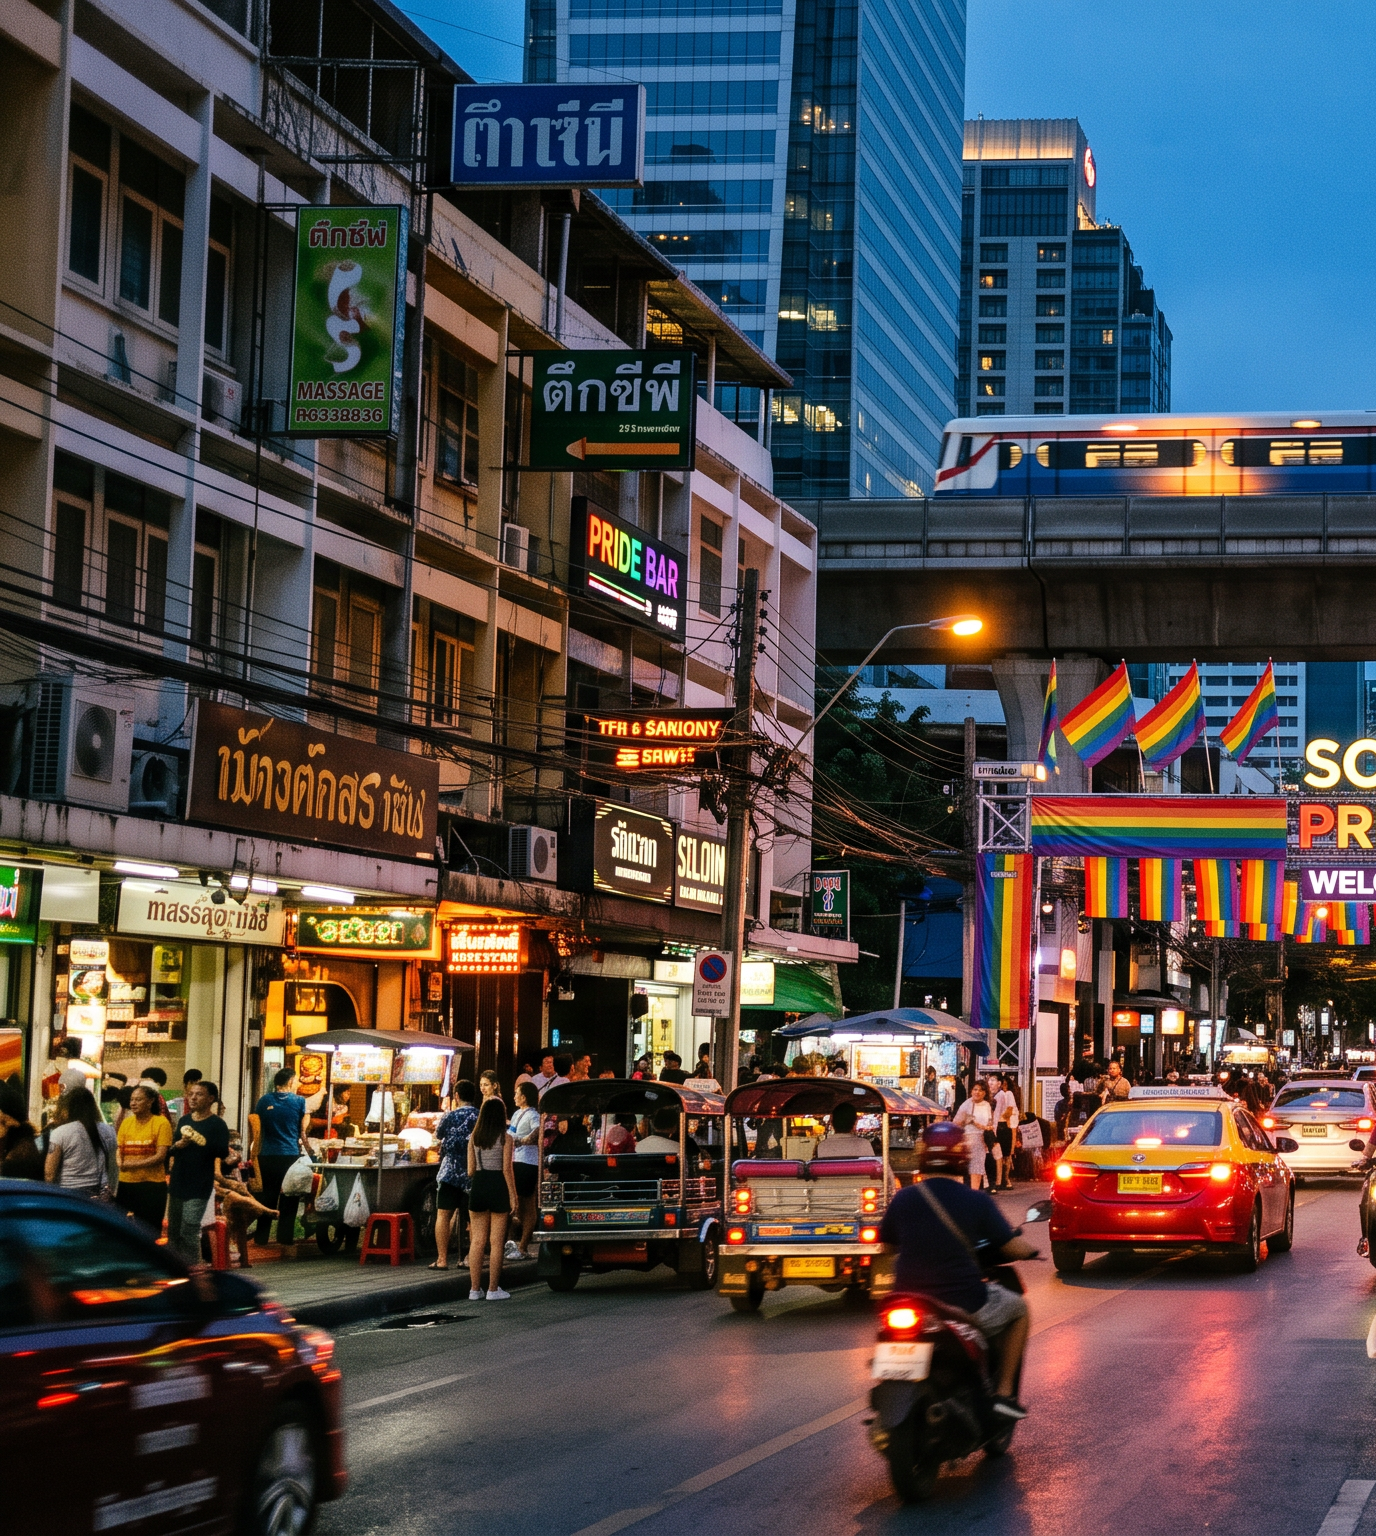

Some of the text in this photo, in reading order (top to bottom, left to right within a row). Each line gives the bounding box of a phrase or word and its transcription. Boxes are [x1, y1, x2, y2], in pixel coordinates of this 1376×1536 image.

[296, 381, 384, 400] MASSAGE
[588, 513, 679, 599] PRIDE BAR
